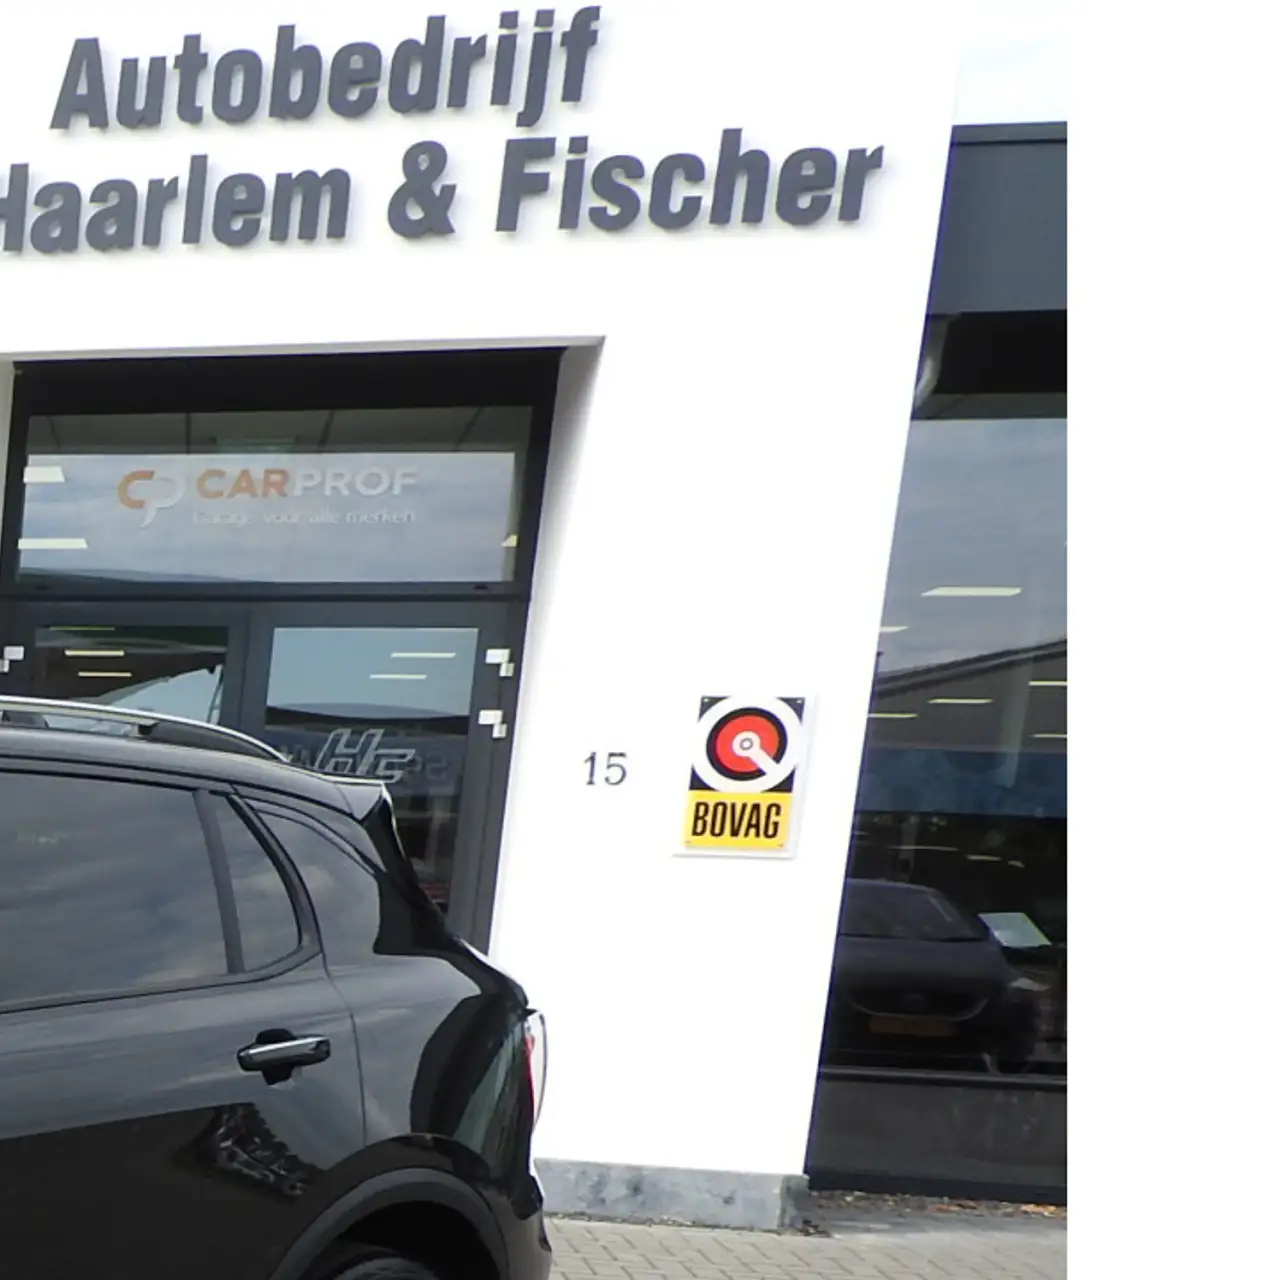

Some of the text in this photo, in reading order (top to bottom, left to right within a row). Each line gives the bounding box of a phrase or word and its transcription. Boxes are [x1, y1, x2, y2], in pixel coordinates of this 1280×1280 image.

[50, 6, 601, 129] Autobedrijf
[387, 140, 457, 236] &
[496, 127, 886, 233] Fischer
[196, 466, 419, 499] CARPROF
[263, 511, 299, 524] voor
[309, 509, 338, 524] alle
[346, 508, 415, 524] merken
[583, 751, 628, 786] 15
[691, 801, 782, 839] BOVAG
